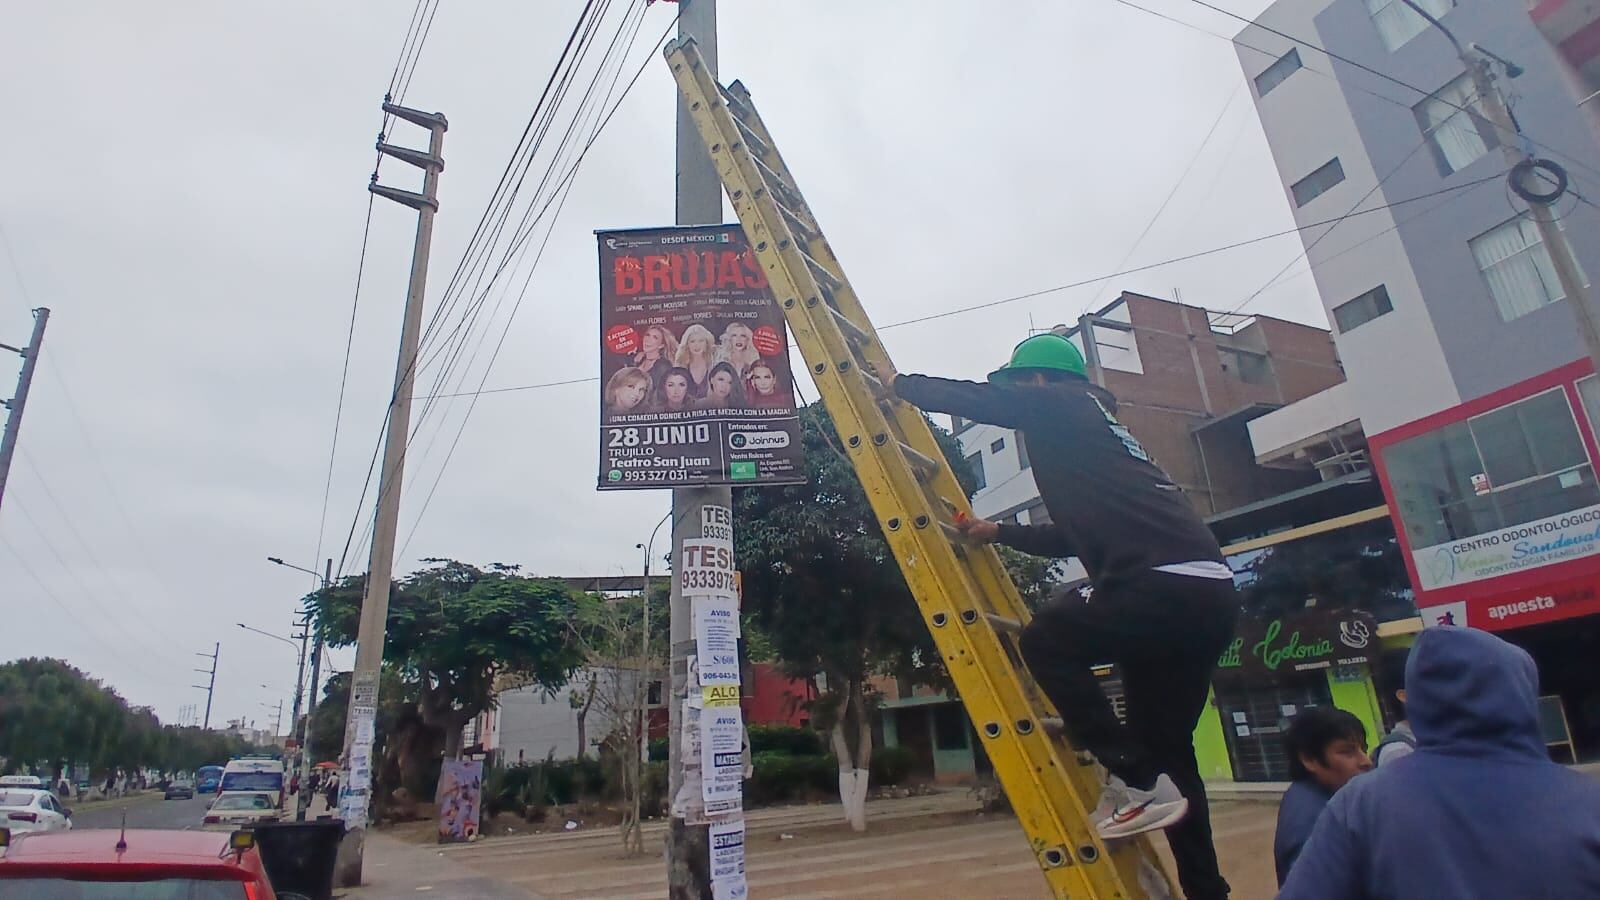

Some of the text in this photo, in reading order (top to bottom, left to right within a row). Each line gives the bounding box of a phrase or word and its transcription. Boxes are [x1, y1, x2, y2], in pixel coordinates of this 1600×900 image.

[661, 236, 686, 244] DESDE
[627, 413, 659, 422] COMEDIA
[659, 412, 682, 420] DONDE
[682, 411, 692, 419] LA
[692, 409, 708, 417] RISA
[717, 408, 743, 416] MEZCLA
[608, 427, 640, 448] 28
[642, 423, 710, 445] JUNIO
[608, 447, 655, 458] TRUJILLO
[609, 455, 711, 469] Teatro San Juan
[624, 470, 646, 481] 993
[647, 469, 668, 481] 327
[668, 469, 688, 480] 031
[704, 507, 730, 526] TES
[1452, 509, 1600, 555] CENTRO ODONTOLÓGICO
[1546, 543, 1595, 561] FAMILIAR
[1252, 619, 1334, 671] Colonia
[716, 717, 737, 725] AVISO
